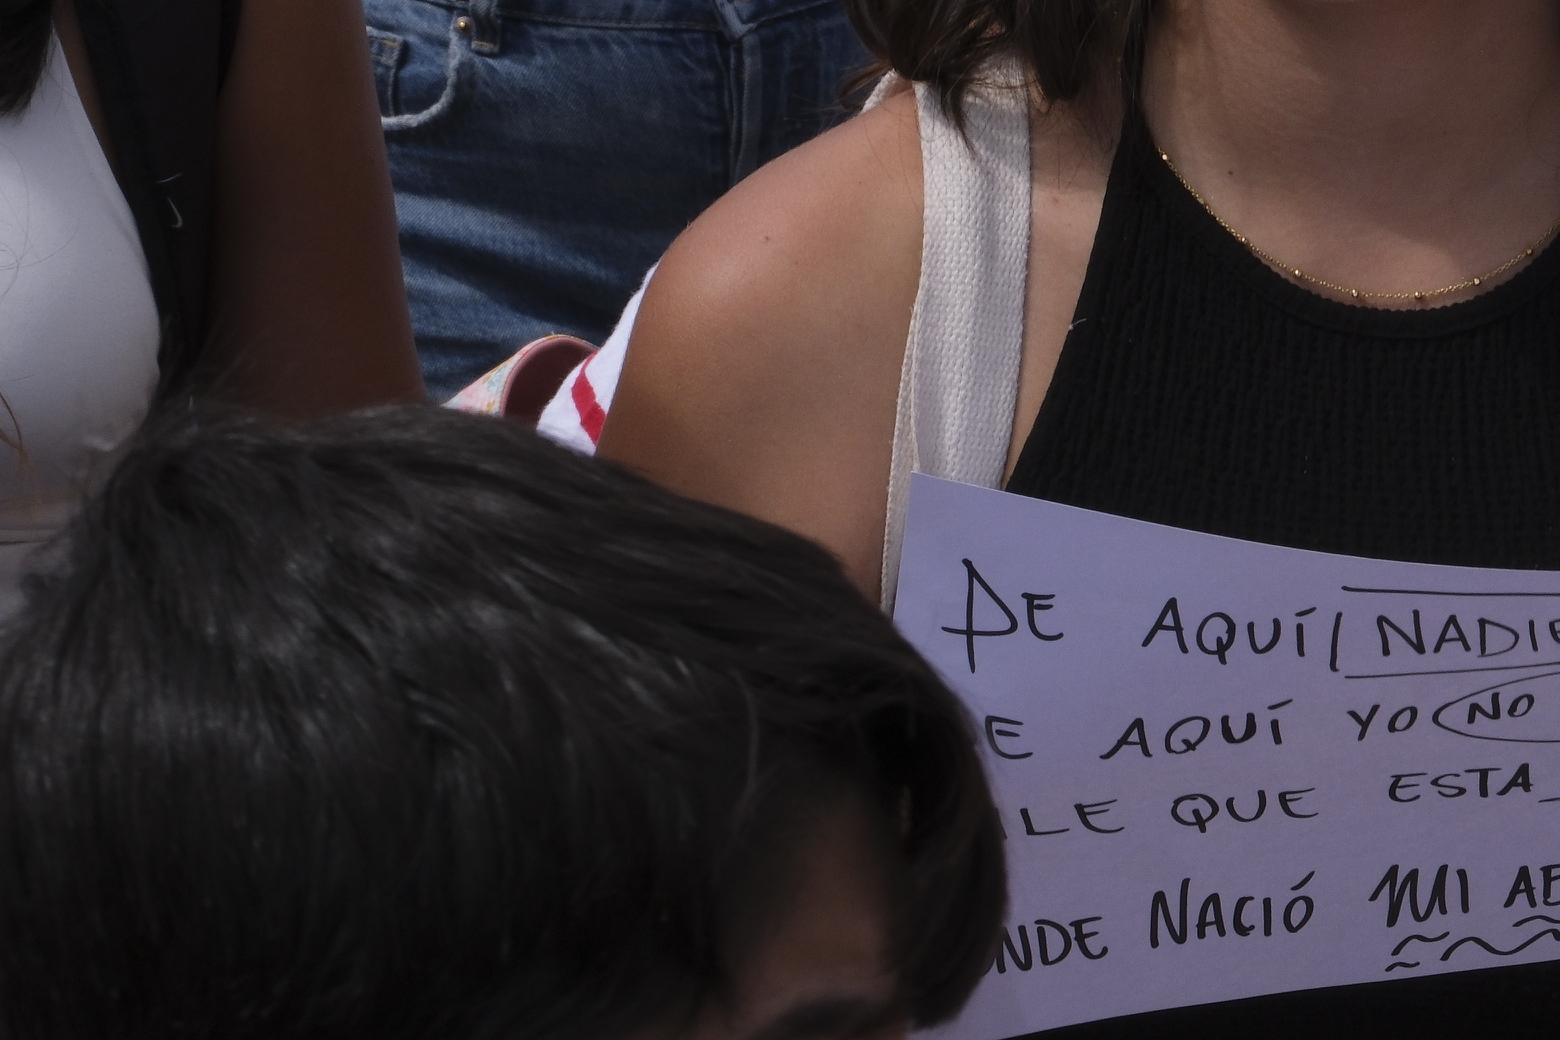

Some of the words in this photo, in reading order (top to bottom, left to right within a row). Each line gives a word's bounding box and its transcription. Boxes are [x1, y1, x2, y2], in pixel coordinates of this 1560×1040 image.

[941, 558, 1064, 673] DE
[984, 715, 1034, 760] E
[1100, 699, 1293, 760] AQUÍ
[1347, 704, 1420, 741] YO
[1466, 693, 1536, 726] NO
[996, 798, 1126, 840] LE
[1170, 787, 1320, 833] QUE
[1388, 763, 1535, 803] ESTA
[984, 916, 1110, 975] NDE
[1368, 863, 1470, 928] MI
